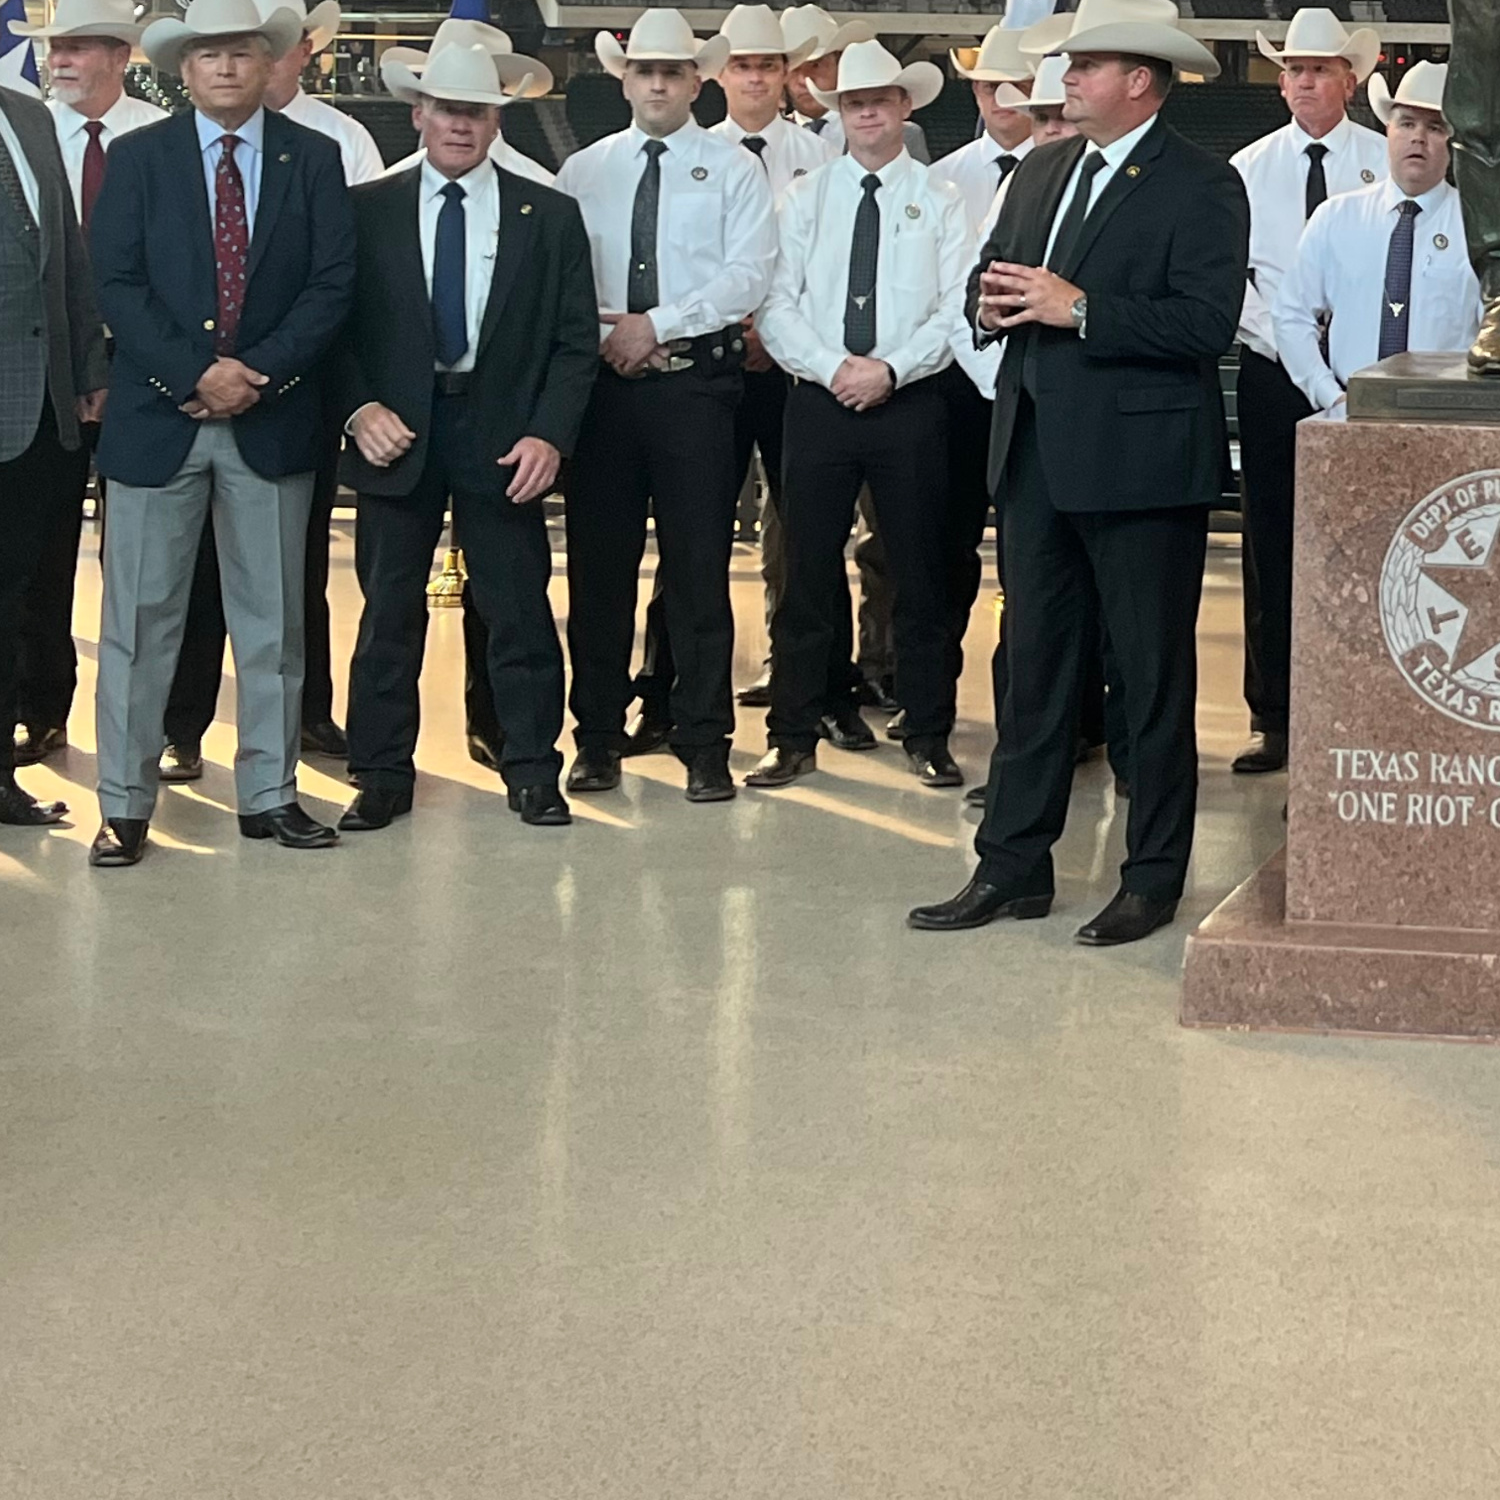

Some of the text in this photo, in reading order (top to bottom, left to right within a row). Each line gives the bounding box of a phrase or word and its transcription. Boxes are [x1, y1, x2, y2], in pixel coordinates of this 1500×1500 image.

[1410, 498, 1458, 540] DEPT.
[1455, 483, 1478, 507] OF
[1412, 656, 1480, 716] TEXAS
[1328, 748, 1419, 782] TEXAS
